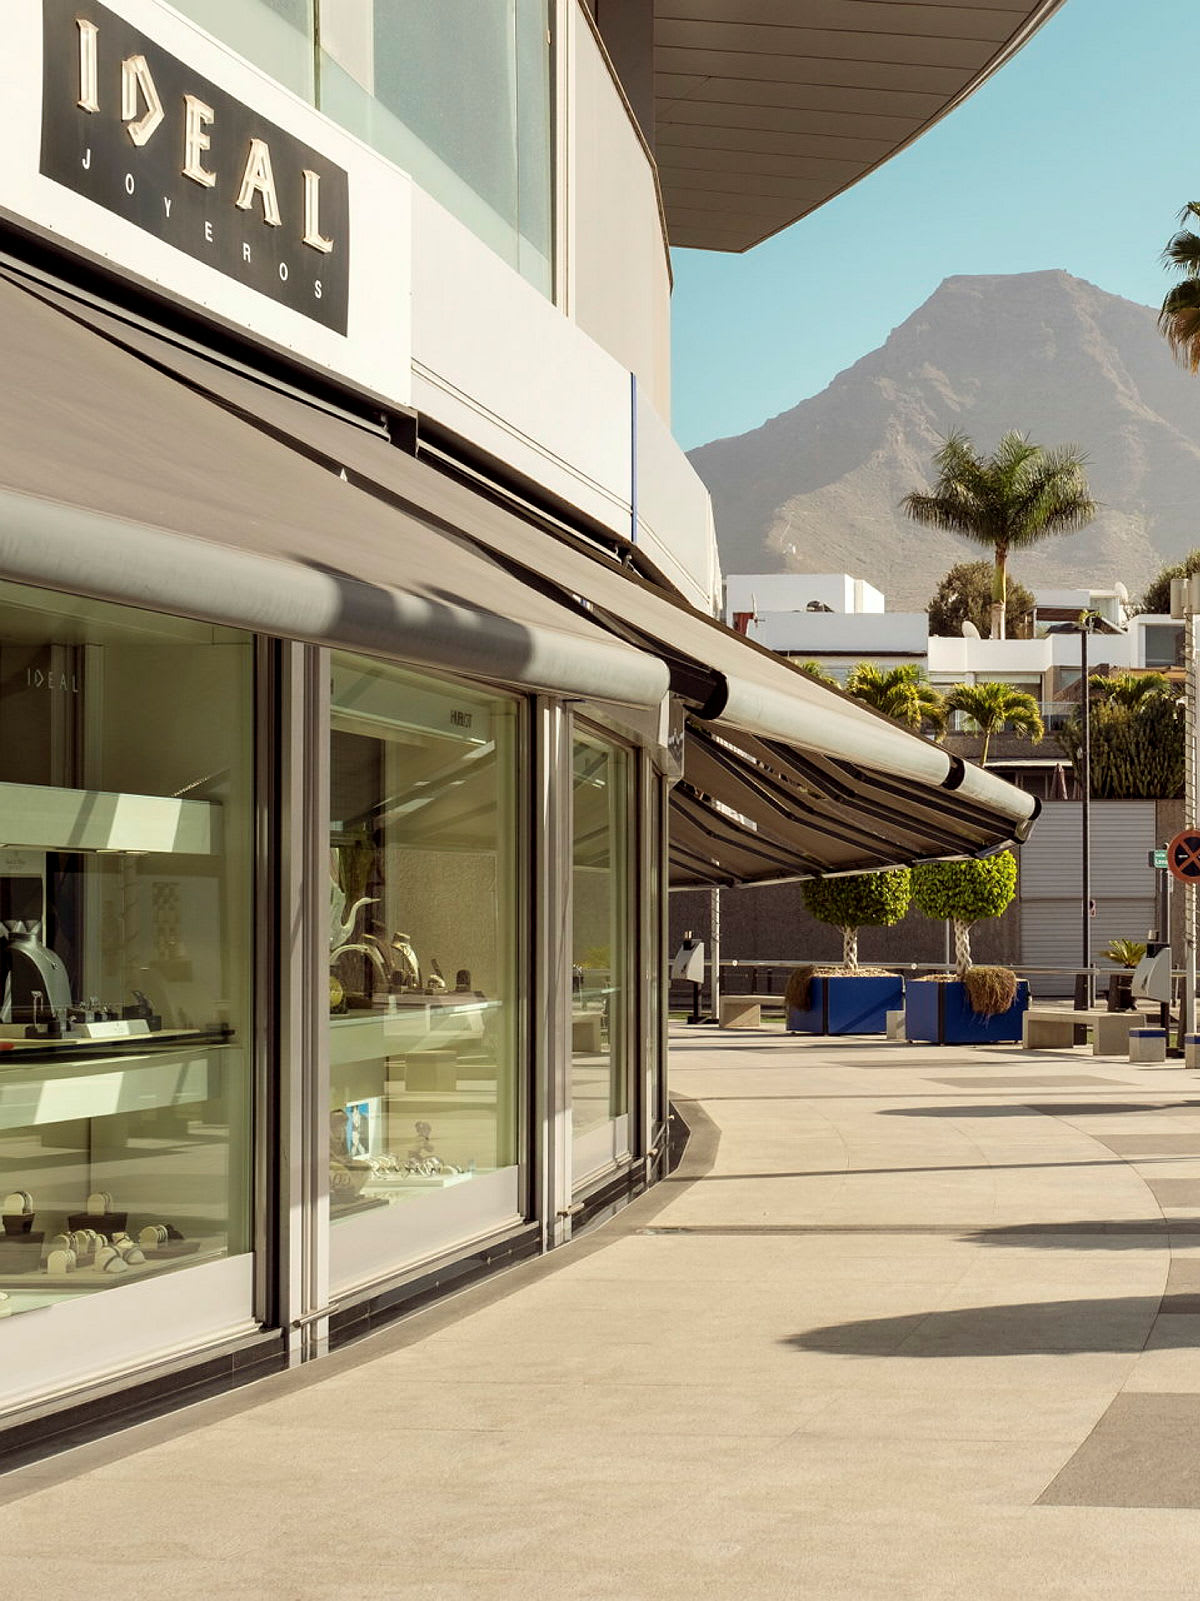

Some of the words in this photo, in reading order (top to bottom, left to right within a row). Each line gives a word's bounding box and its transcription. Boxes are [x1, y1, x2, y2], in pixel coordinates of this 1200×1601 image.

[76, 18, 334, 253] IDEAL
[81, 147, 322, 299] JOYEROS
[27, 667, 79, 693] IDEAL
